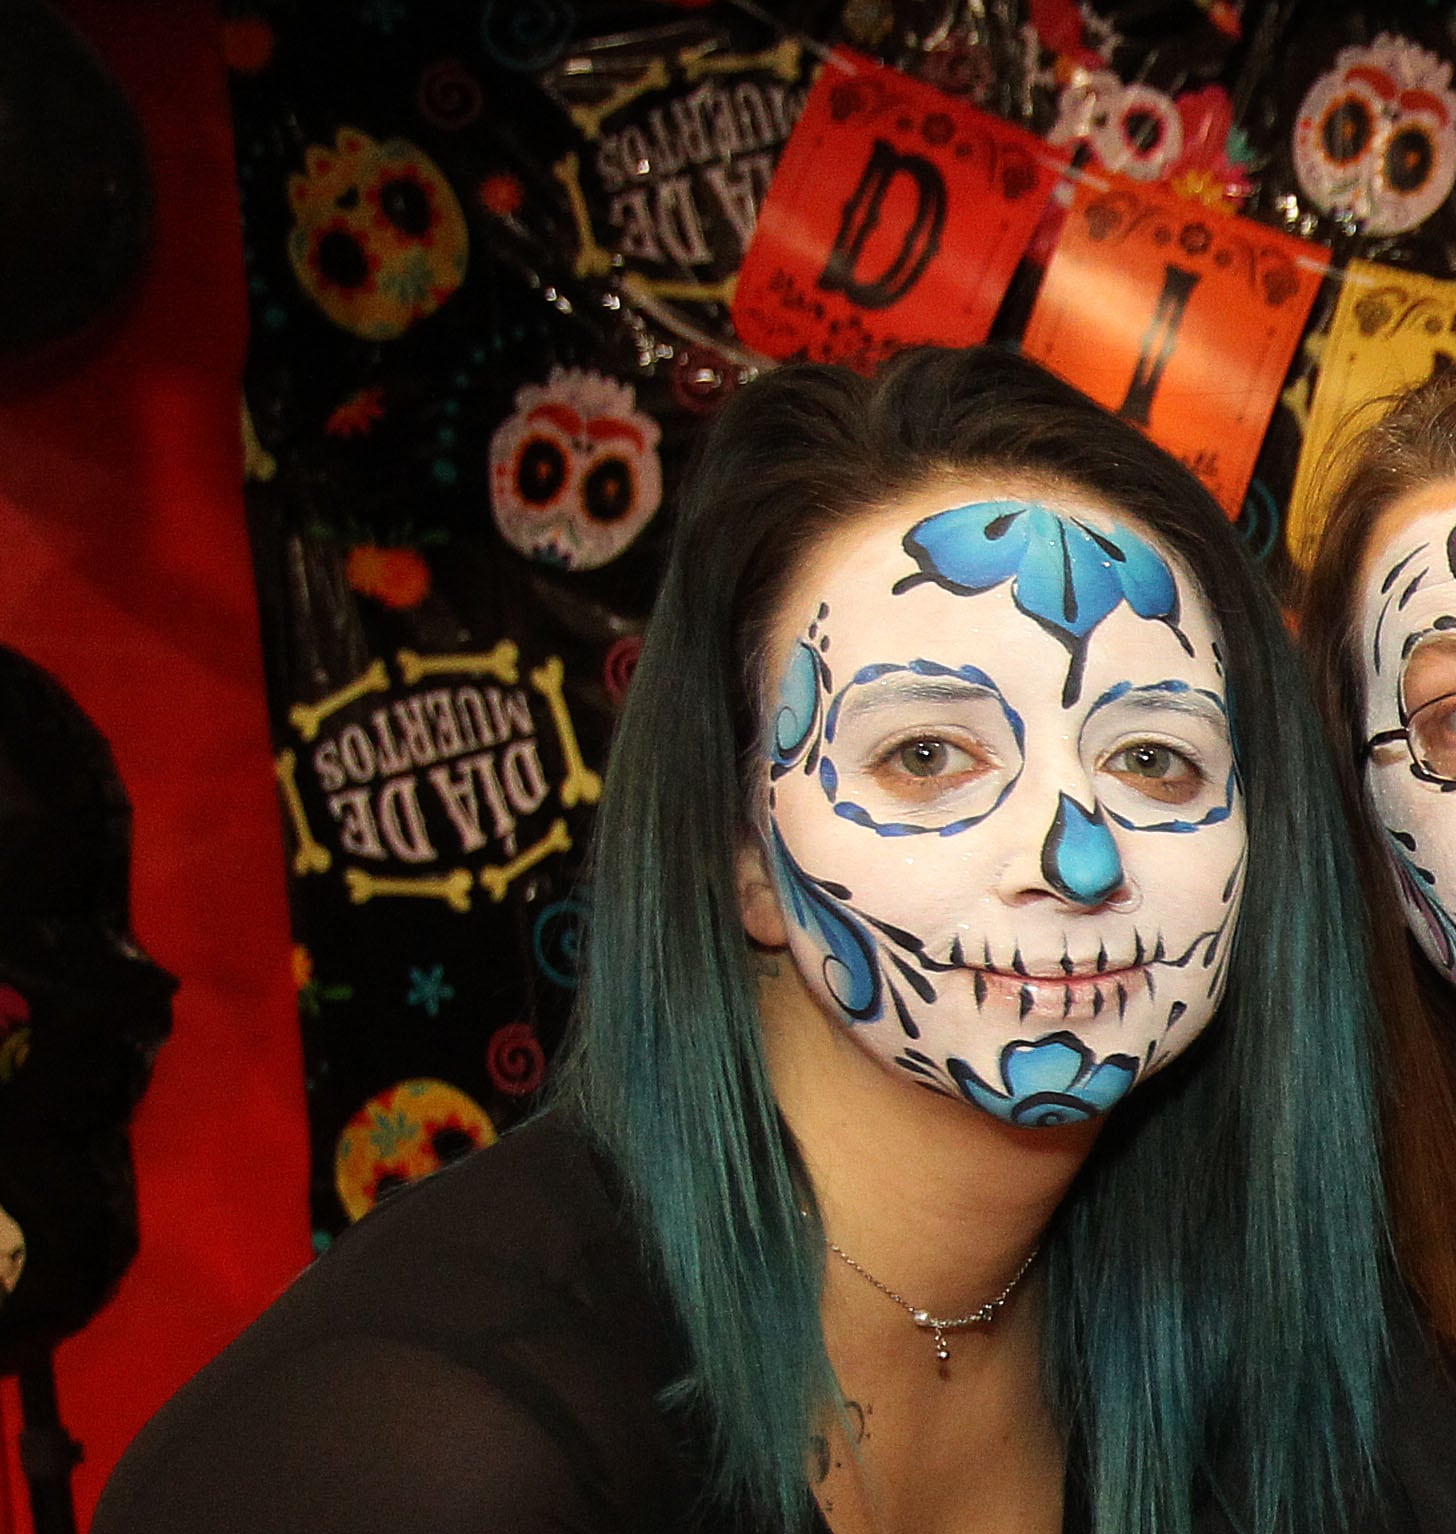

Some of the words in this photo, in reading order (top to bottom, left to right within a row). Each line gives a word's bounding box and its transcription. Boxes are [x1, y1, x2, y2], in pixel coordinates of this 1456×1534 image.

[608, 173, 713, 265] DE
[819, 137, 945, 309] D
[313, 687, 534, 791] MUERTOS
[328, 774, 438, 862] DE
[427, 740, 549, 856] DÍA
